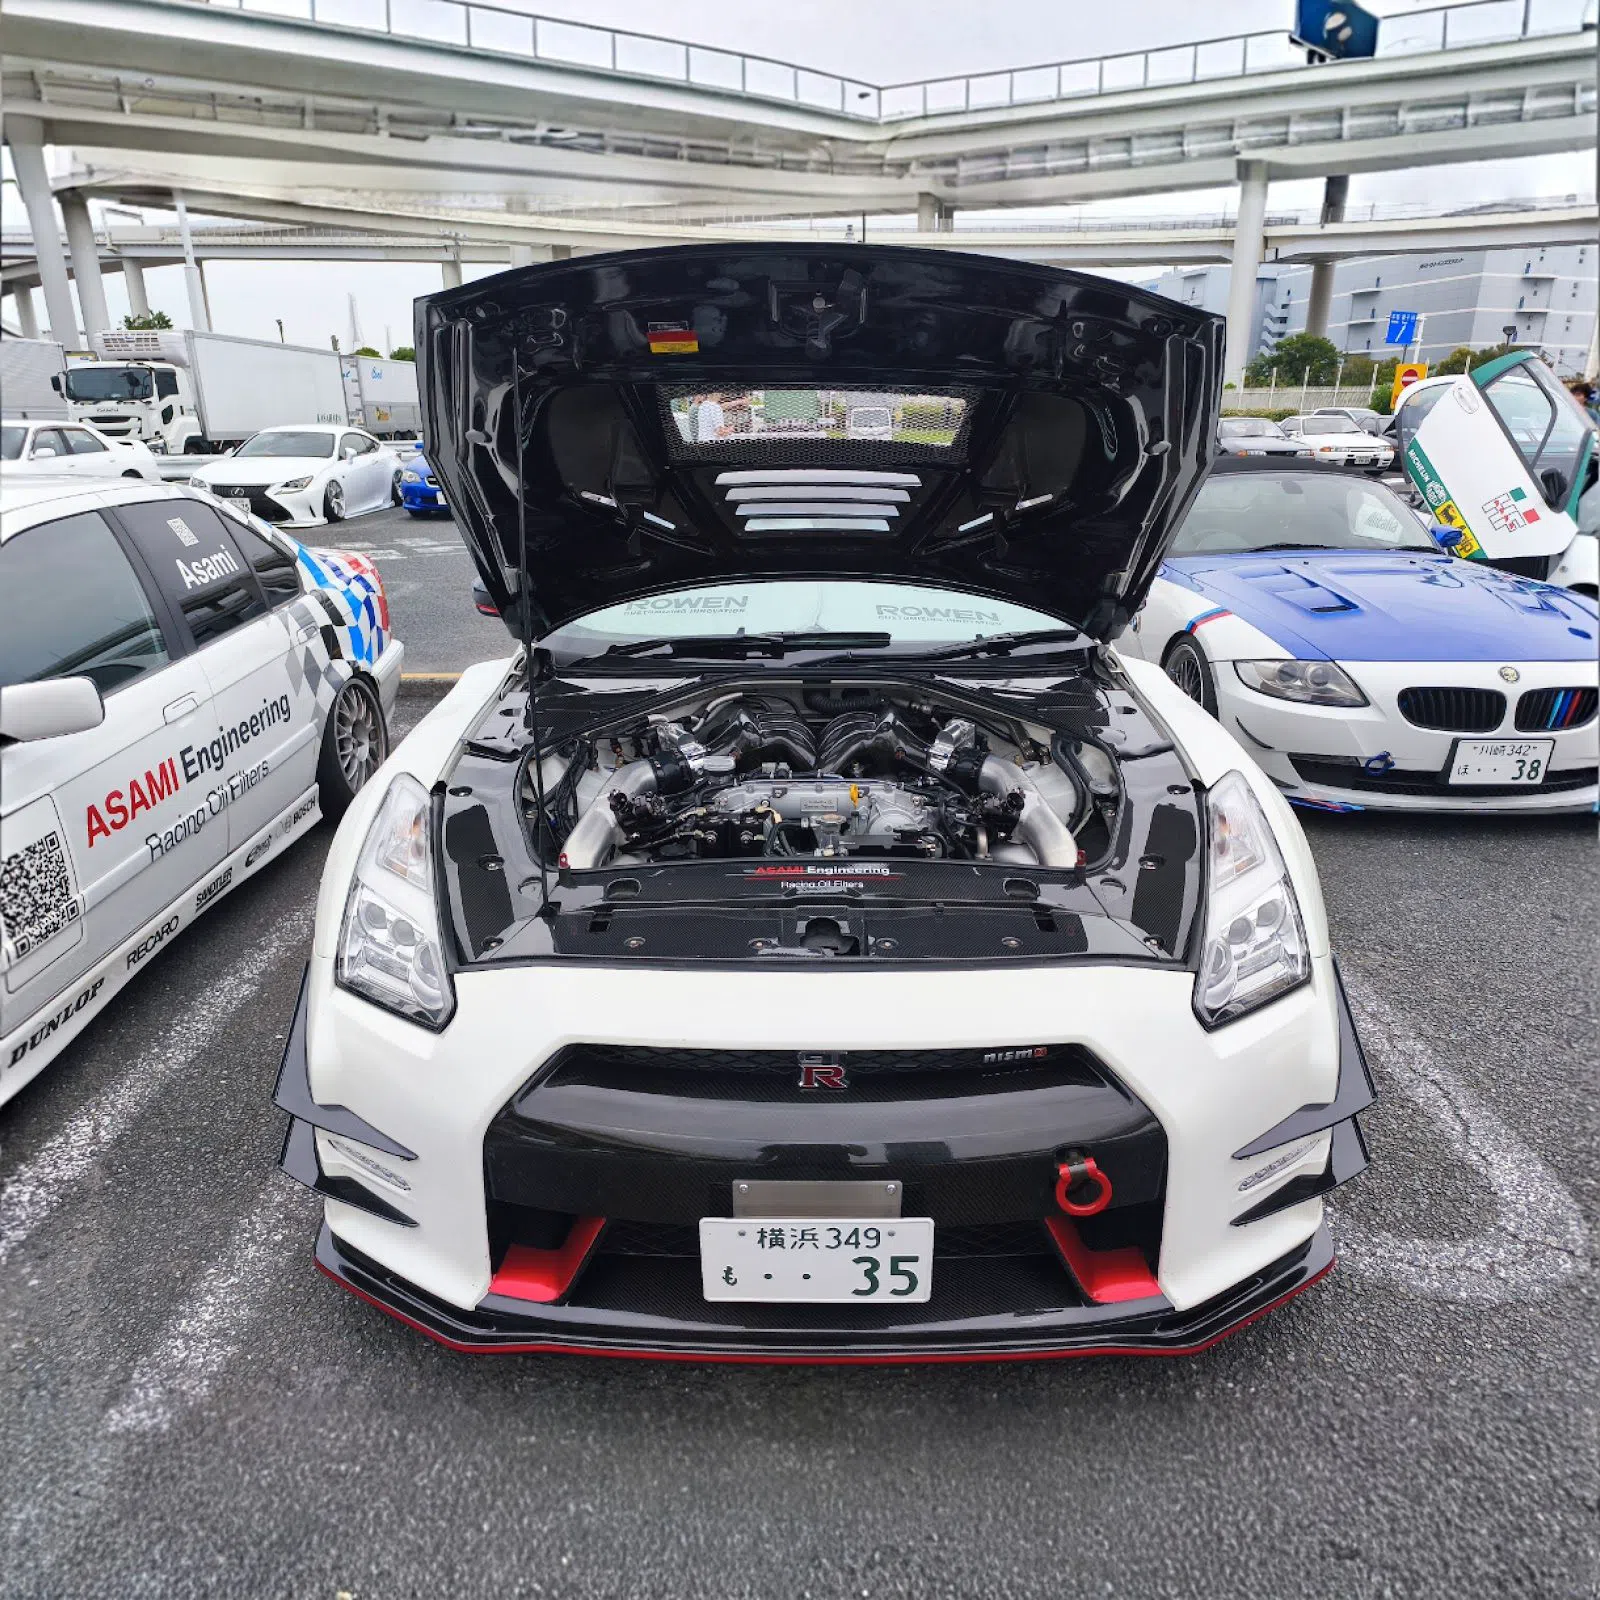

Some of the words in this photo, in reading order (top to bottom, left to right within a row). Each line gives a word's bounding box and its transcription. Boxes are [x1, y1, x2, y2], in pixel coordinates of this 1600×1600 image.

[1408, 450, 1430, 482] MICHELIN
[175, 544, 239, 589] Asami
[624, 596, 748, 611] ROWEN
[876, 605, 1000, 621] ROWEN
[86, 757, 180, 848] ASAMI
[179, 694, 291, 785] Engineering
[1511, 759, 1541, 781] 38
[145, 807, 206, 863] Racing
[206, 784, 229, 816] Oil
[227, 760, 270, 801] Filters
[293, 796, 316, 824] BOSCH
[807, 865, 890, 876] Engineering
[126, 915, 179, 970] RECARO
[8, 977, 105, 1068] DUNLOP
[756, 1227, 881, 1250] 横浜349
[722, 1266, 738, 1286] も
[851, 1255, 919, 1296] 35
